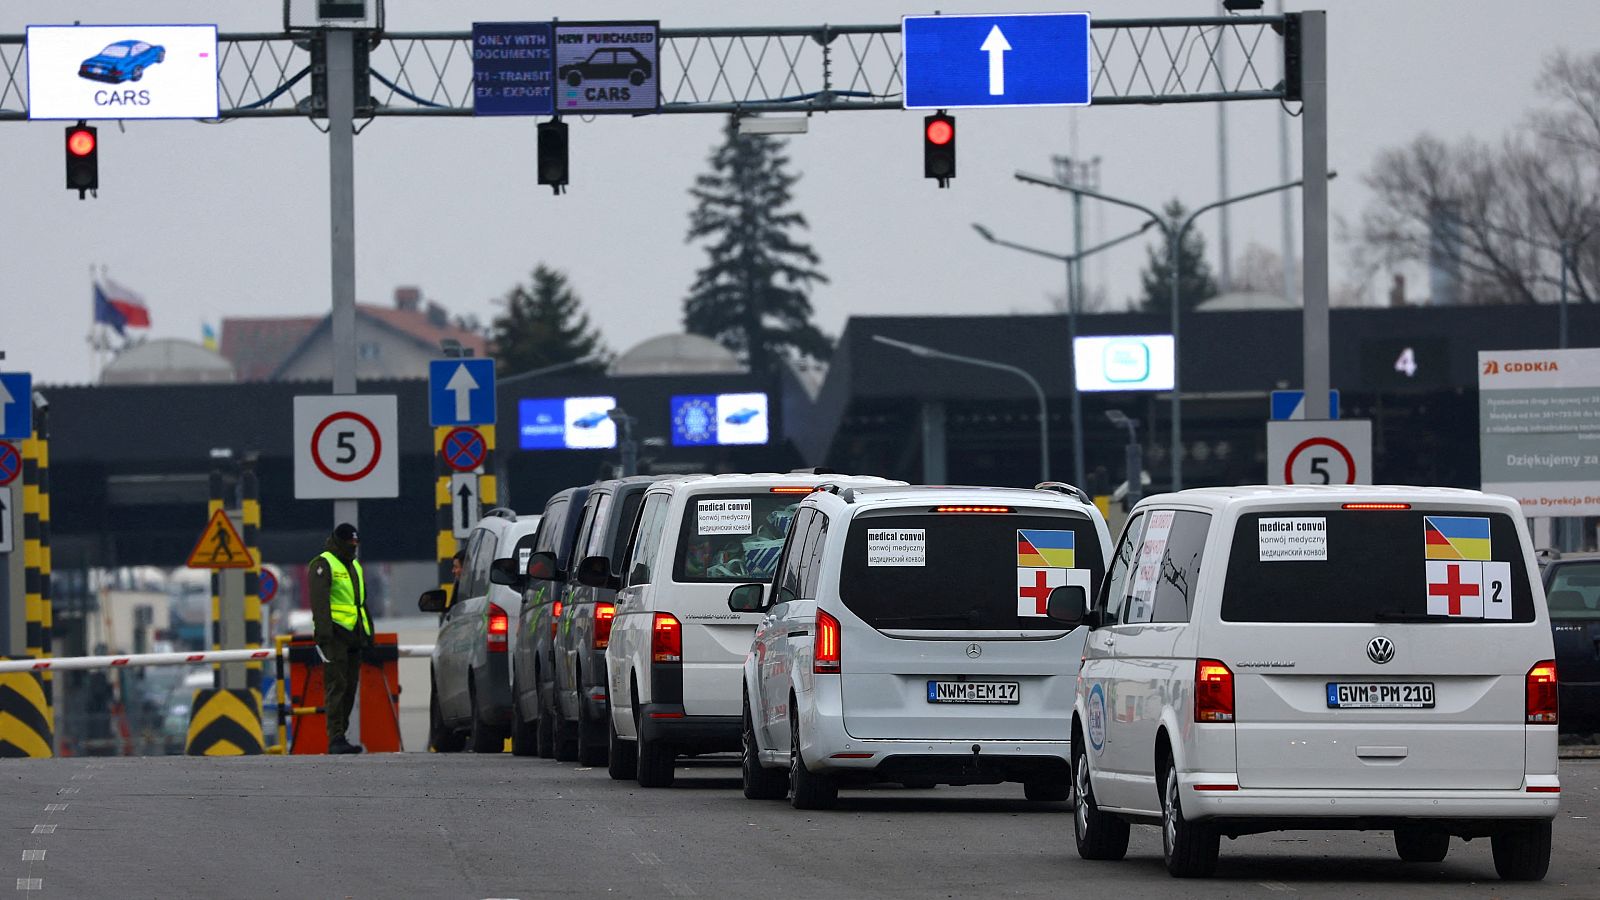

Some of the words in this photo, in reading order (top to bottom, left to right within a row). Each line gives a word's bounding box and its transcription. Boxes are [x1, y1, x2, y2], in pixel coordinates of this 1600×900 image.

[479, 35, 512, 45] ONLY
[515, 35, 546, 45] WITH
[559, 34, 583, 44] NEW
[587, 32, 654, 43] PURCHASED
[475, 49, 550, 59] DOCUMENTS
[499, 71, 551, 81] TRANSIT
[503, 86, 551, 97] EXPORT
[585, 87, 631, 101] CARS
[94, 90, 151, 106] CARS
[1394, 347, 1417, 377] 4
[1504, 361, 1559, 373] GDDKiA
[336, 432, 356, 464] 5
[1506, 454, 1580, 468] Dziękujemy
[1583, 455, 1599, 464] za
[1310, 457, 1330, 485] 5
[699, 502, 726, 512] medical
[721, 514, 751, 522] medyczny
[1260, 521, 1294, 532] medical
[869, 531, 898, 541] medical
[1261, 536, 1286, 545] konwój
[1288, 536, 1325, 544] medyczny
[869, 544, 891, 553] konwój
[893, 545, 924, 553] medyczny
[1261, 548, 1303, 558] медицинский
[1304, 548, 1325, 556] конвой
[1491, 580, 1503, 603] 2
[937, 684, 967, 699] NWM
[976, 685, 996, 699] EM
[998, 684, 1017, 699] 17
[1339, 686, 1369, 702] GVM
[1380, 686, 1401, 702] PM
[1403, 685, 1432, 702] 210
